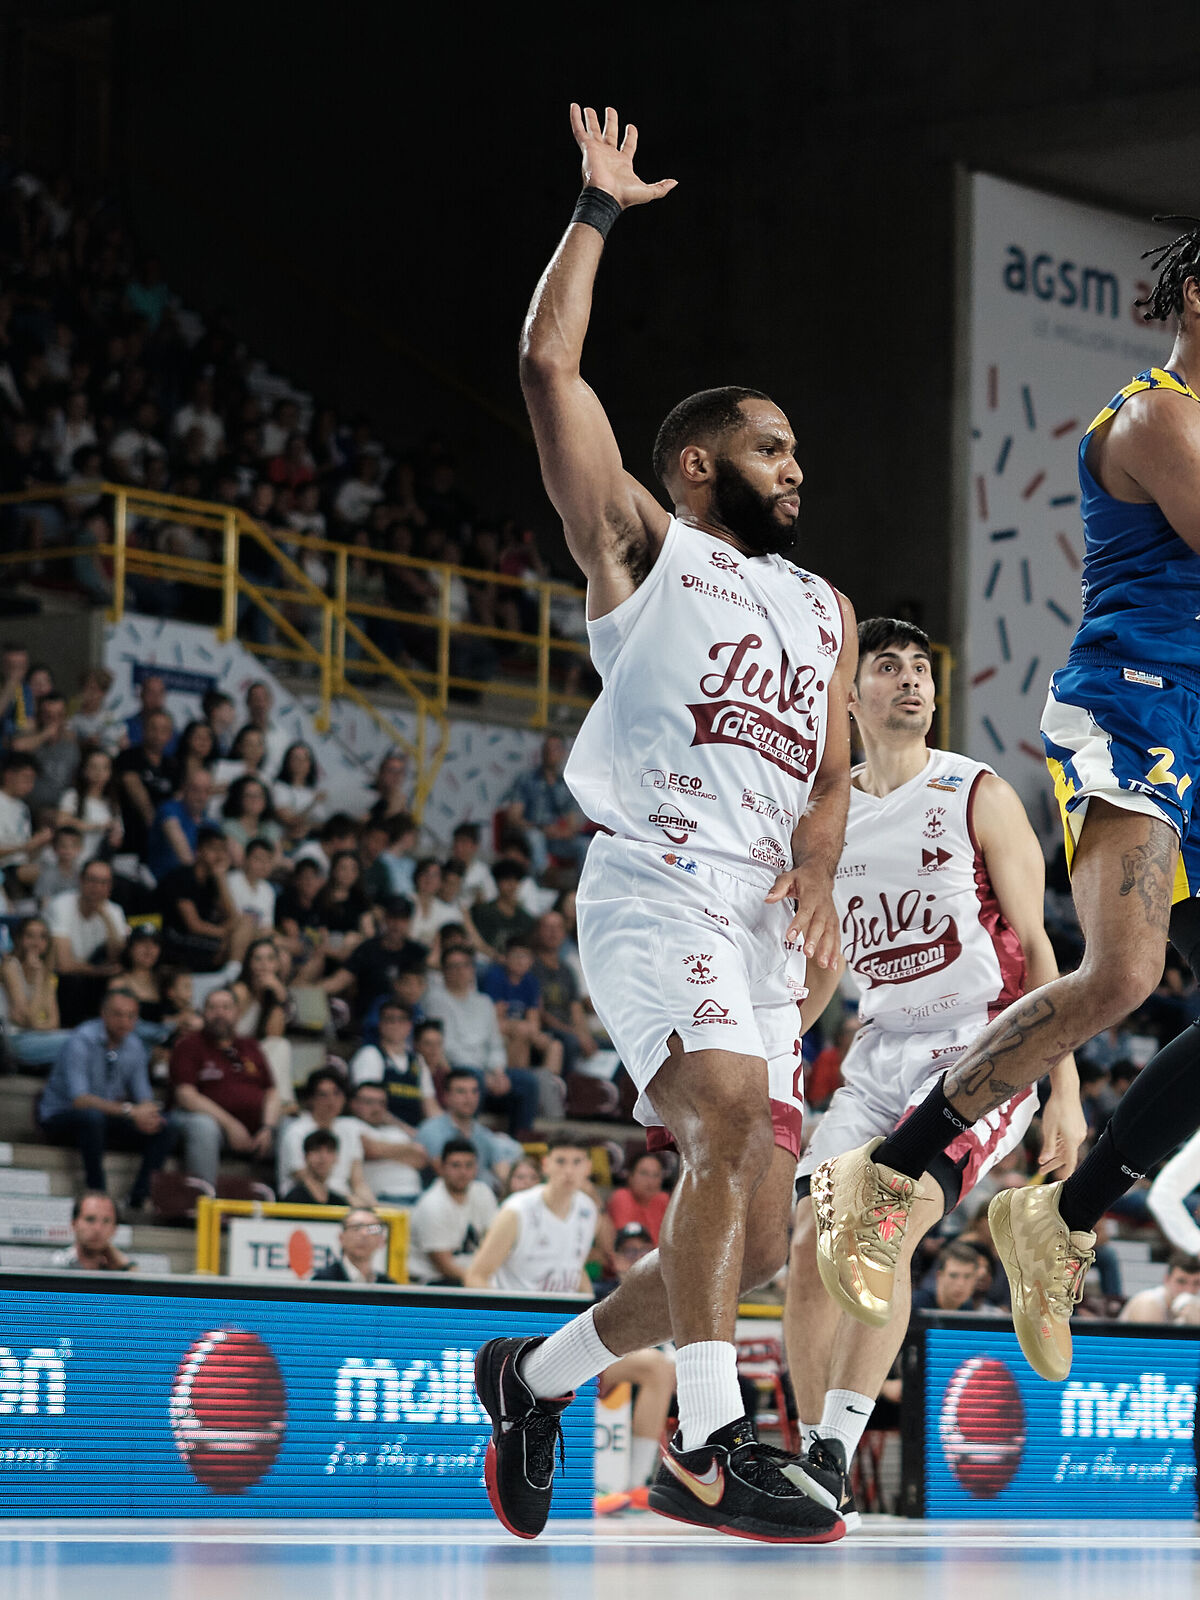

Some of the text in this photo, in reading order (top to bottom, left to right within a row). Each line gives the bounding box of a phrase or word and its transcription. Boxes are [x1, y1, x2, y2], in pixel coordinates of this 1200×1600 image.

[1003, 245, 1120, 320] agsm
[741, 710, 813, 766] Ferraroi
[667, 785, 717, 801] FOTOVOLTAICO
[648, 814, 698, 829] GORINI
[682, 953, 713, 965] JU-VI
[869, 949, 945, 981] Ferraroni
[691, 1018, 738, 1027] ACERBIS
[335, 1348, 492, 1424] molt
[1061, 1373, 1198, 1439] molte
